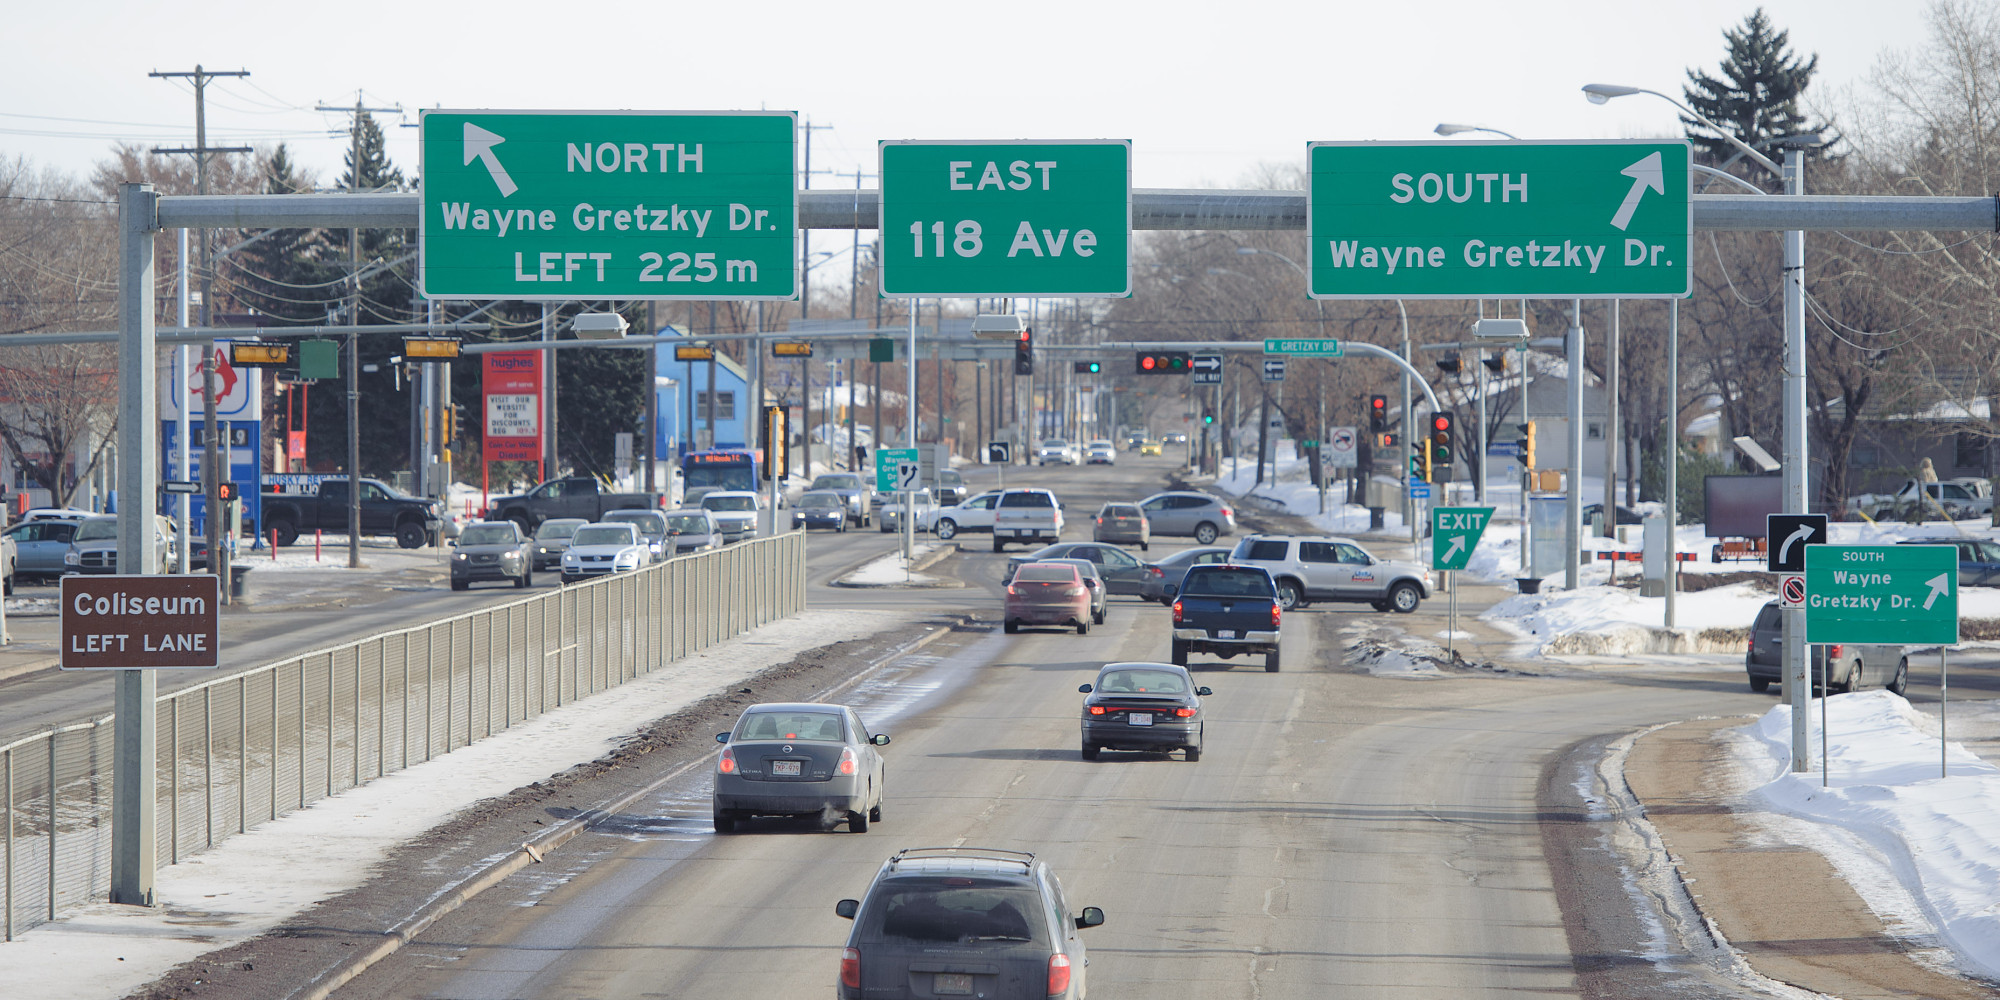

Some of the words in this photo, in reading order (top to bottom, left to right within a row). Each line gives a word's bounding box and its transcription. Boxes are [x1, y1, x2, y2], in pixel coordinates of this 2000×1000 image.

[567, 142, 703, 173] NORTH
[949, 160, 1057, 191] EAST
[1389, 172, 1528, 204] SOUTH
[441, 202, 557, 238] Wayne
[572, 202, 713, 238] Gretzky
[729, 203, 777, 231] Dr.
[910, 219, 983, 258] 118
[1006, 220, 1098, 258] Ave
[1329, 240, 1446, 275] Wayne
[1463, 239, 1606, 274] Gretzky
[1624, 238, 1673, 267] Dr.
[515, 252, 612, 282] LEFT
[1267, 341, 1278, 351] W.
[1281, 341, 1320, 351] GRETZKY
[1322, 341, 1335, 351] DR
[491, 357, 534, 369] hughes
[1194, 373, 1207, 382] ONE
[1208, 373, 1221, 382] WAY
[493, 427, 507, 435] REG
[498, 451, 528, 459] Diesel
[268, 475, 300, 485] HUSKY
[273, 484, 281, 493] 2
[286, 484, 320, 494] MILLIO
[1438, 513, 1484, 530] EXIT
[1842, 552, 1885, 562] SOUTH
[1833, 570, 1892, 588] Wayne
[74, 592, 206, 616] Coliseum
[1810, 594, 1882, 611] Gretzky
[1891, 594, 1916, 609] Dr.
[72, 634, 129, 653] LEFT
[144, 633, 207, 652] LANE
